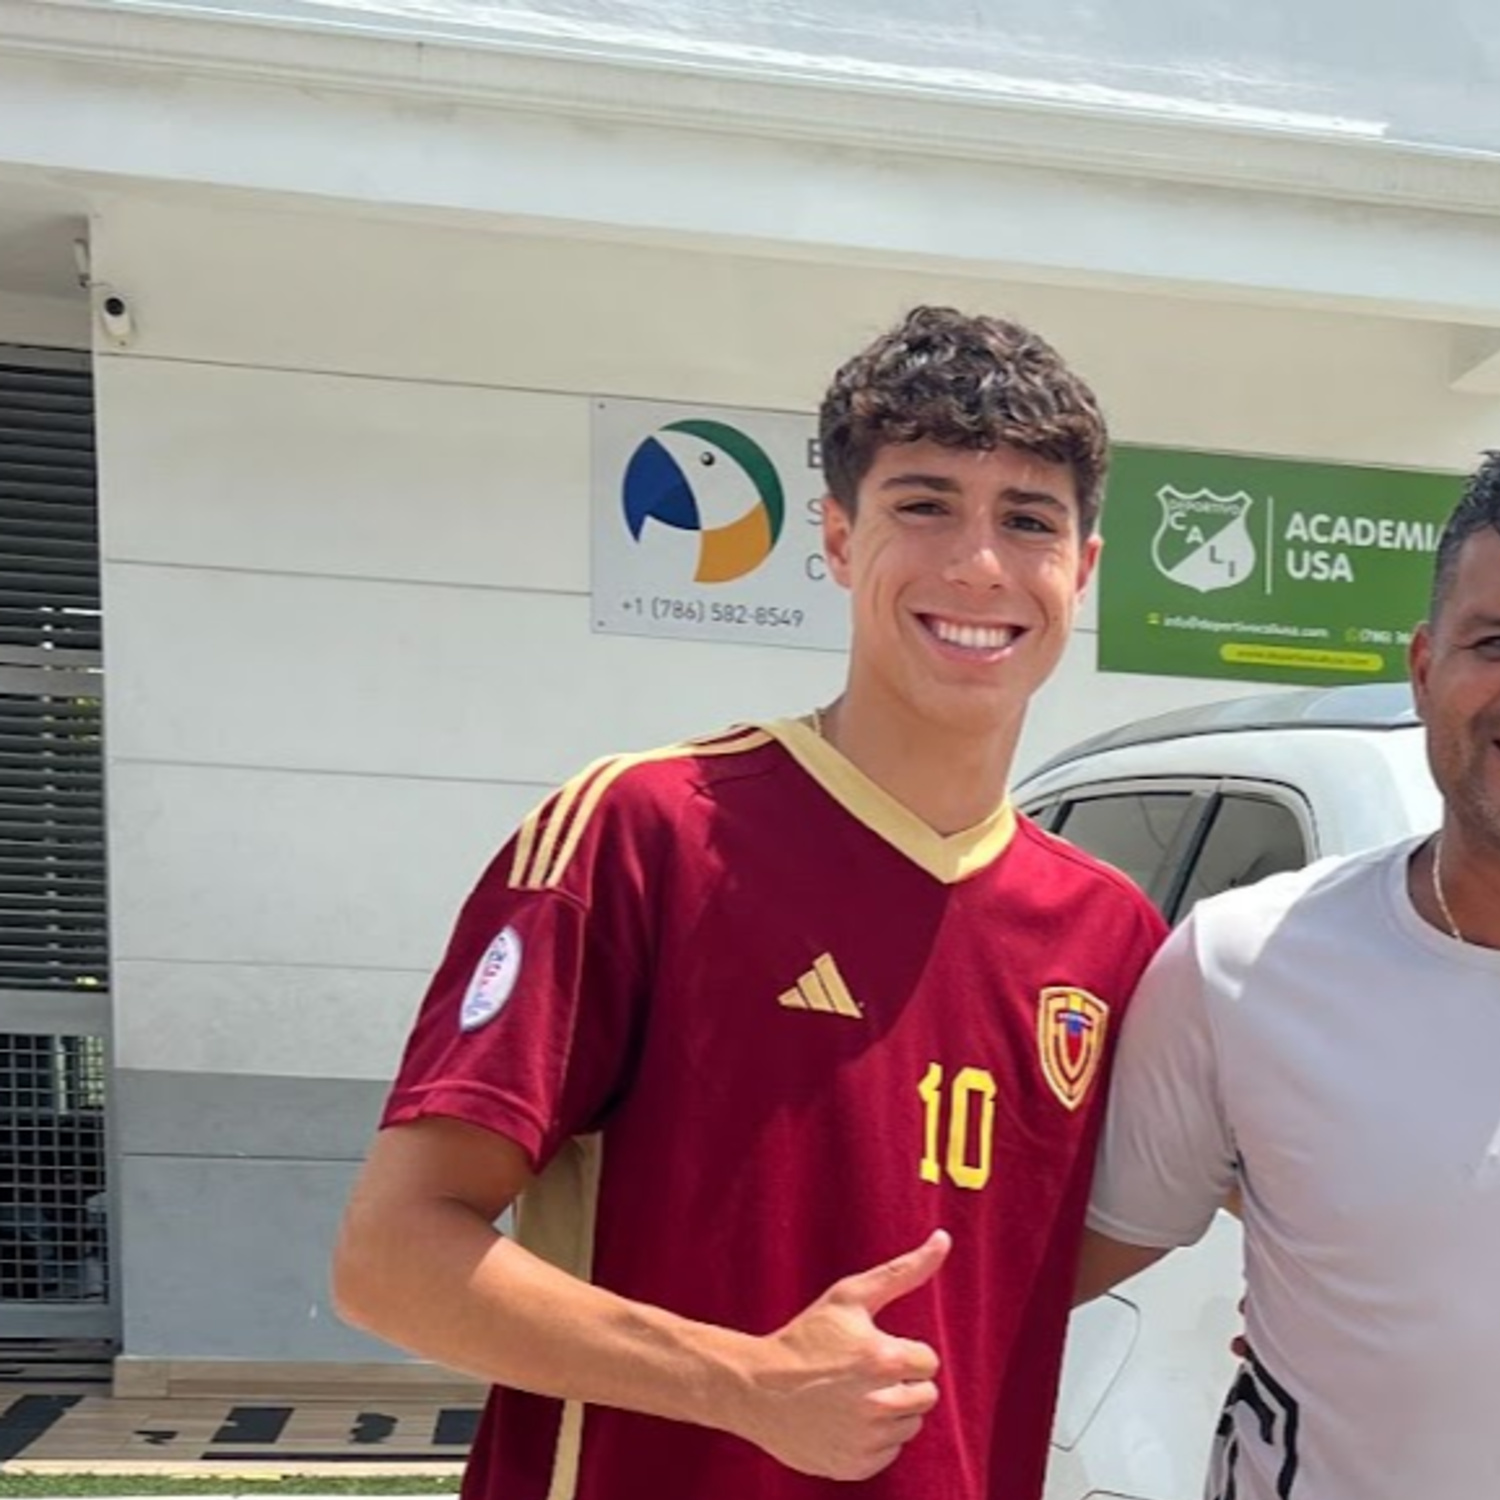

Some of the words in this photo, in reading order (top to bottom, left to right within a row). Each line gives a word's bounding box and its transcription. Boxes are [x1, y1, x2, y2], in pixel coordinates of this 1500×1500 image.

[1285, 548, 1355, 583] USA
[621, 597, 643, 616] +1
[650, 596, 706, 623] (786)
[710, 601, 804, 627] 582-8549
[917, 1062, 997, 1190] 10
